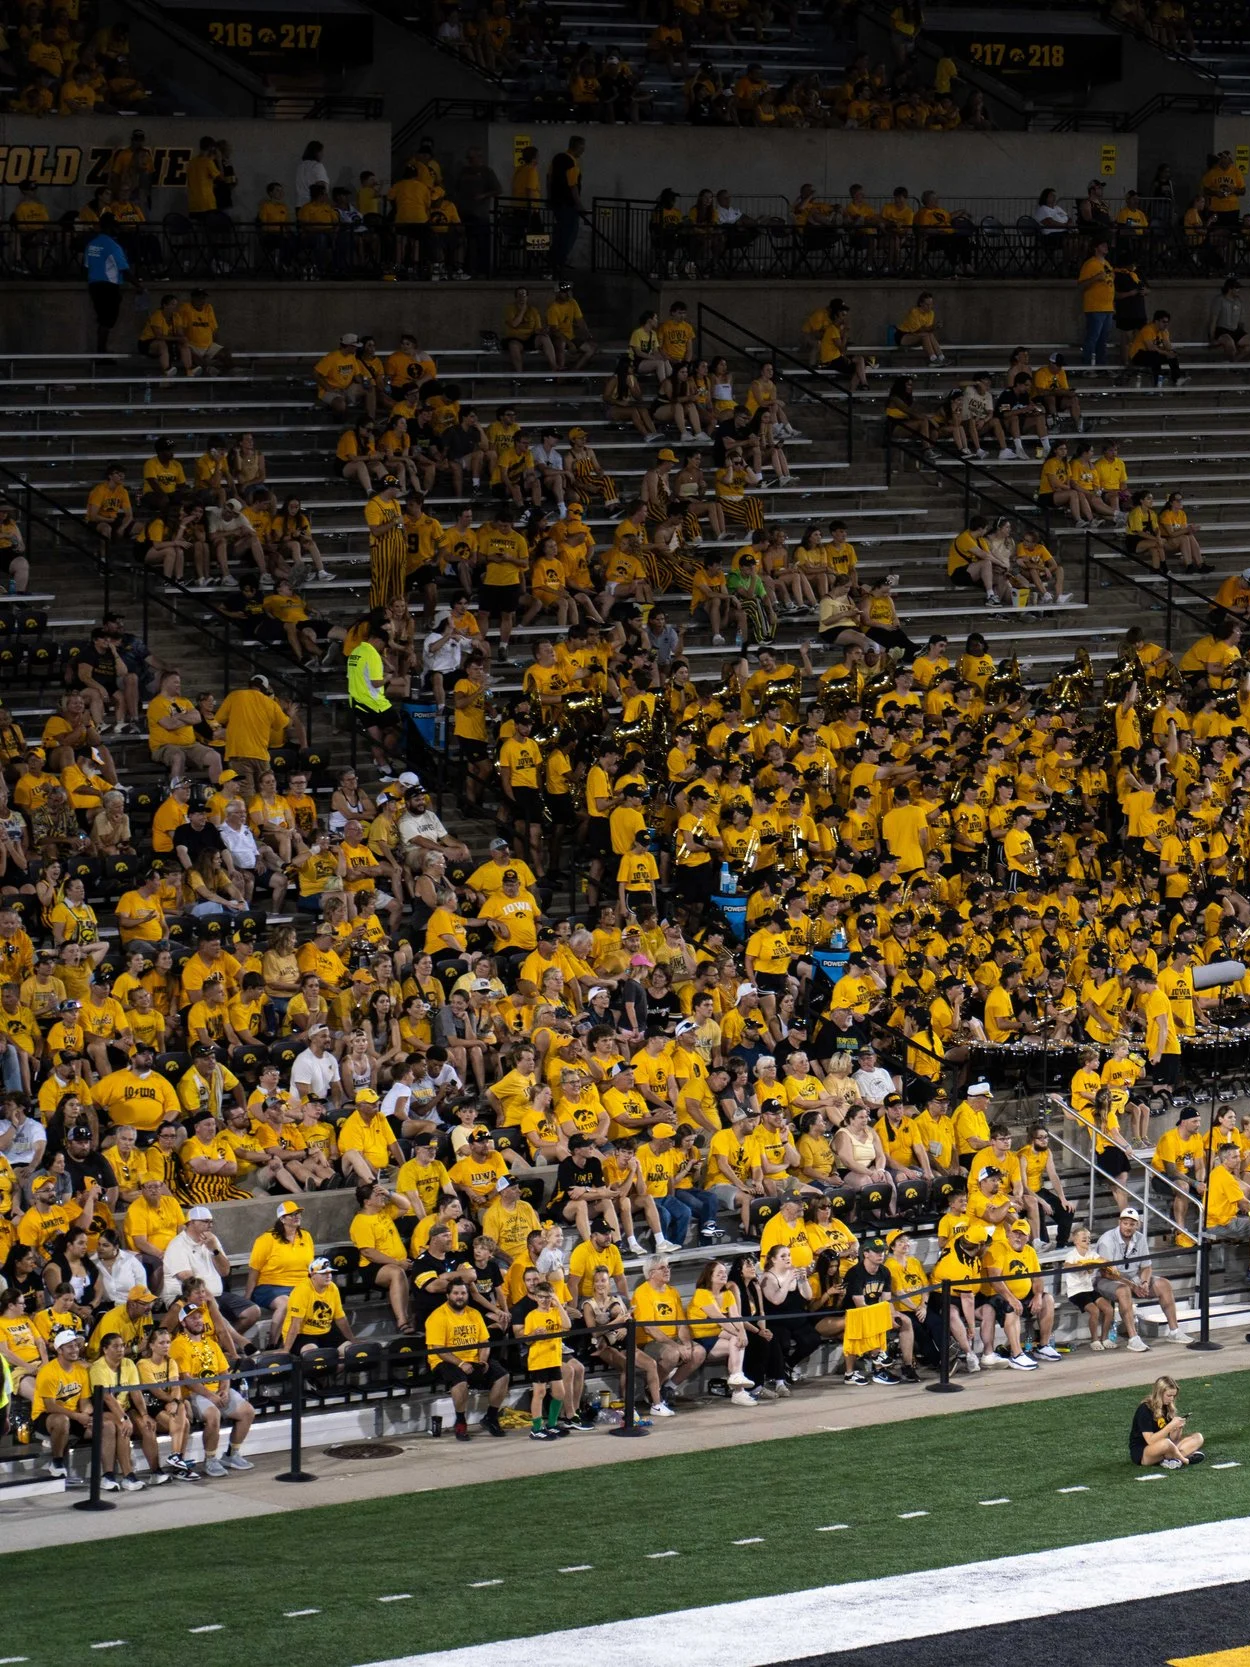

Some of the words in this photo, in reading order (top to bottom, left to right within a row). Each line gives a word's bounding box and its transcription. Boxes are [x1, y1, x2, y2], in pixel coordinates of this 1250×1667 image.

[209, 22, 252, 46] 216
[280, 24, 322, 48] 217
[970, 44, 1006, 65] 217
[1028, 45, 1064, 67] 218
[407, 534, 418, 554] 9
[518, 758, 533, 766] IOWA
[350, 857, 370, 867] IOWA
[502, 901, 532, 916] IOWA
[1171, 988, 1190, 996] IOWA
[650, 1085, 668, 1093] IOW
[577, 1122, 598, 1132] NATION
[655, 1164, 663, 1172] GO
[471, 1172, 497, 1180] IOWA
[573, 1173, 593, 1182] IOWA
[647, 1171, 669, 1182] HAWKS
[7, 1323, 29, 1333] IOWA
